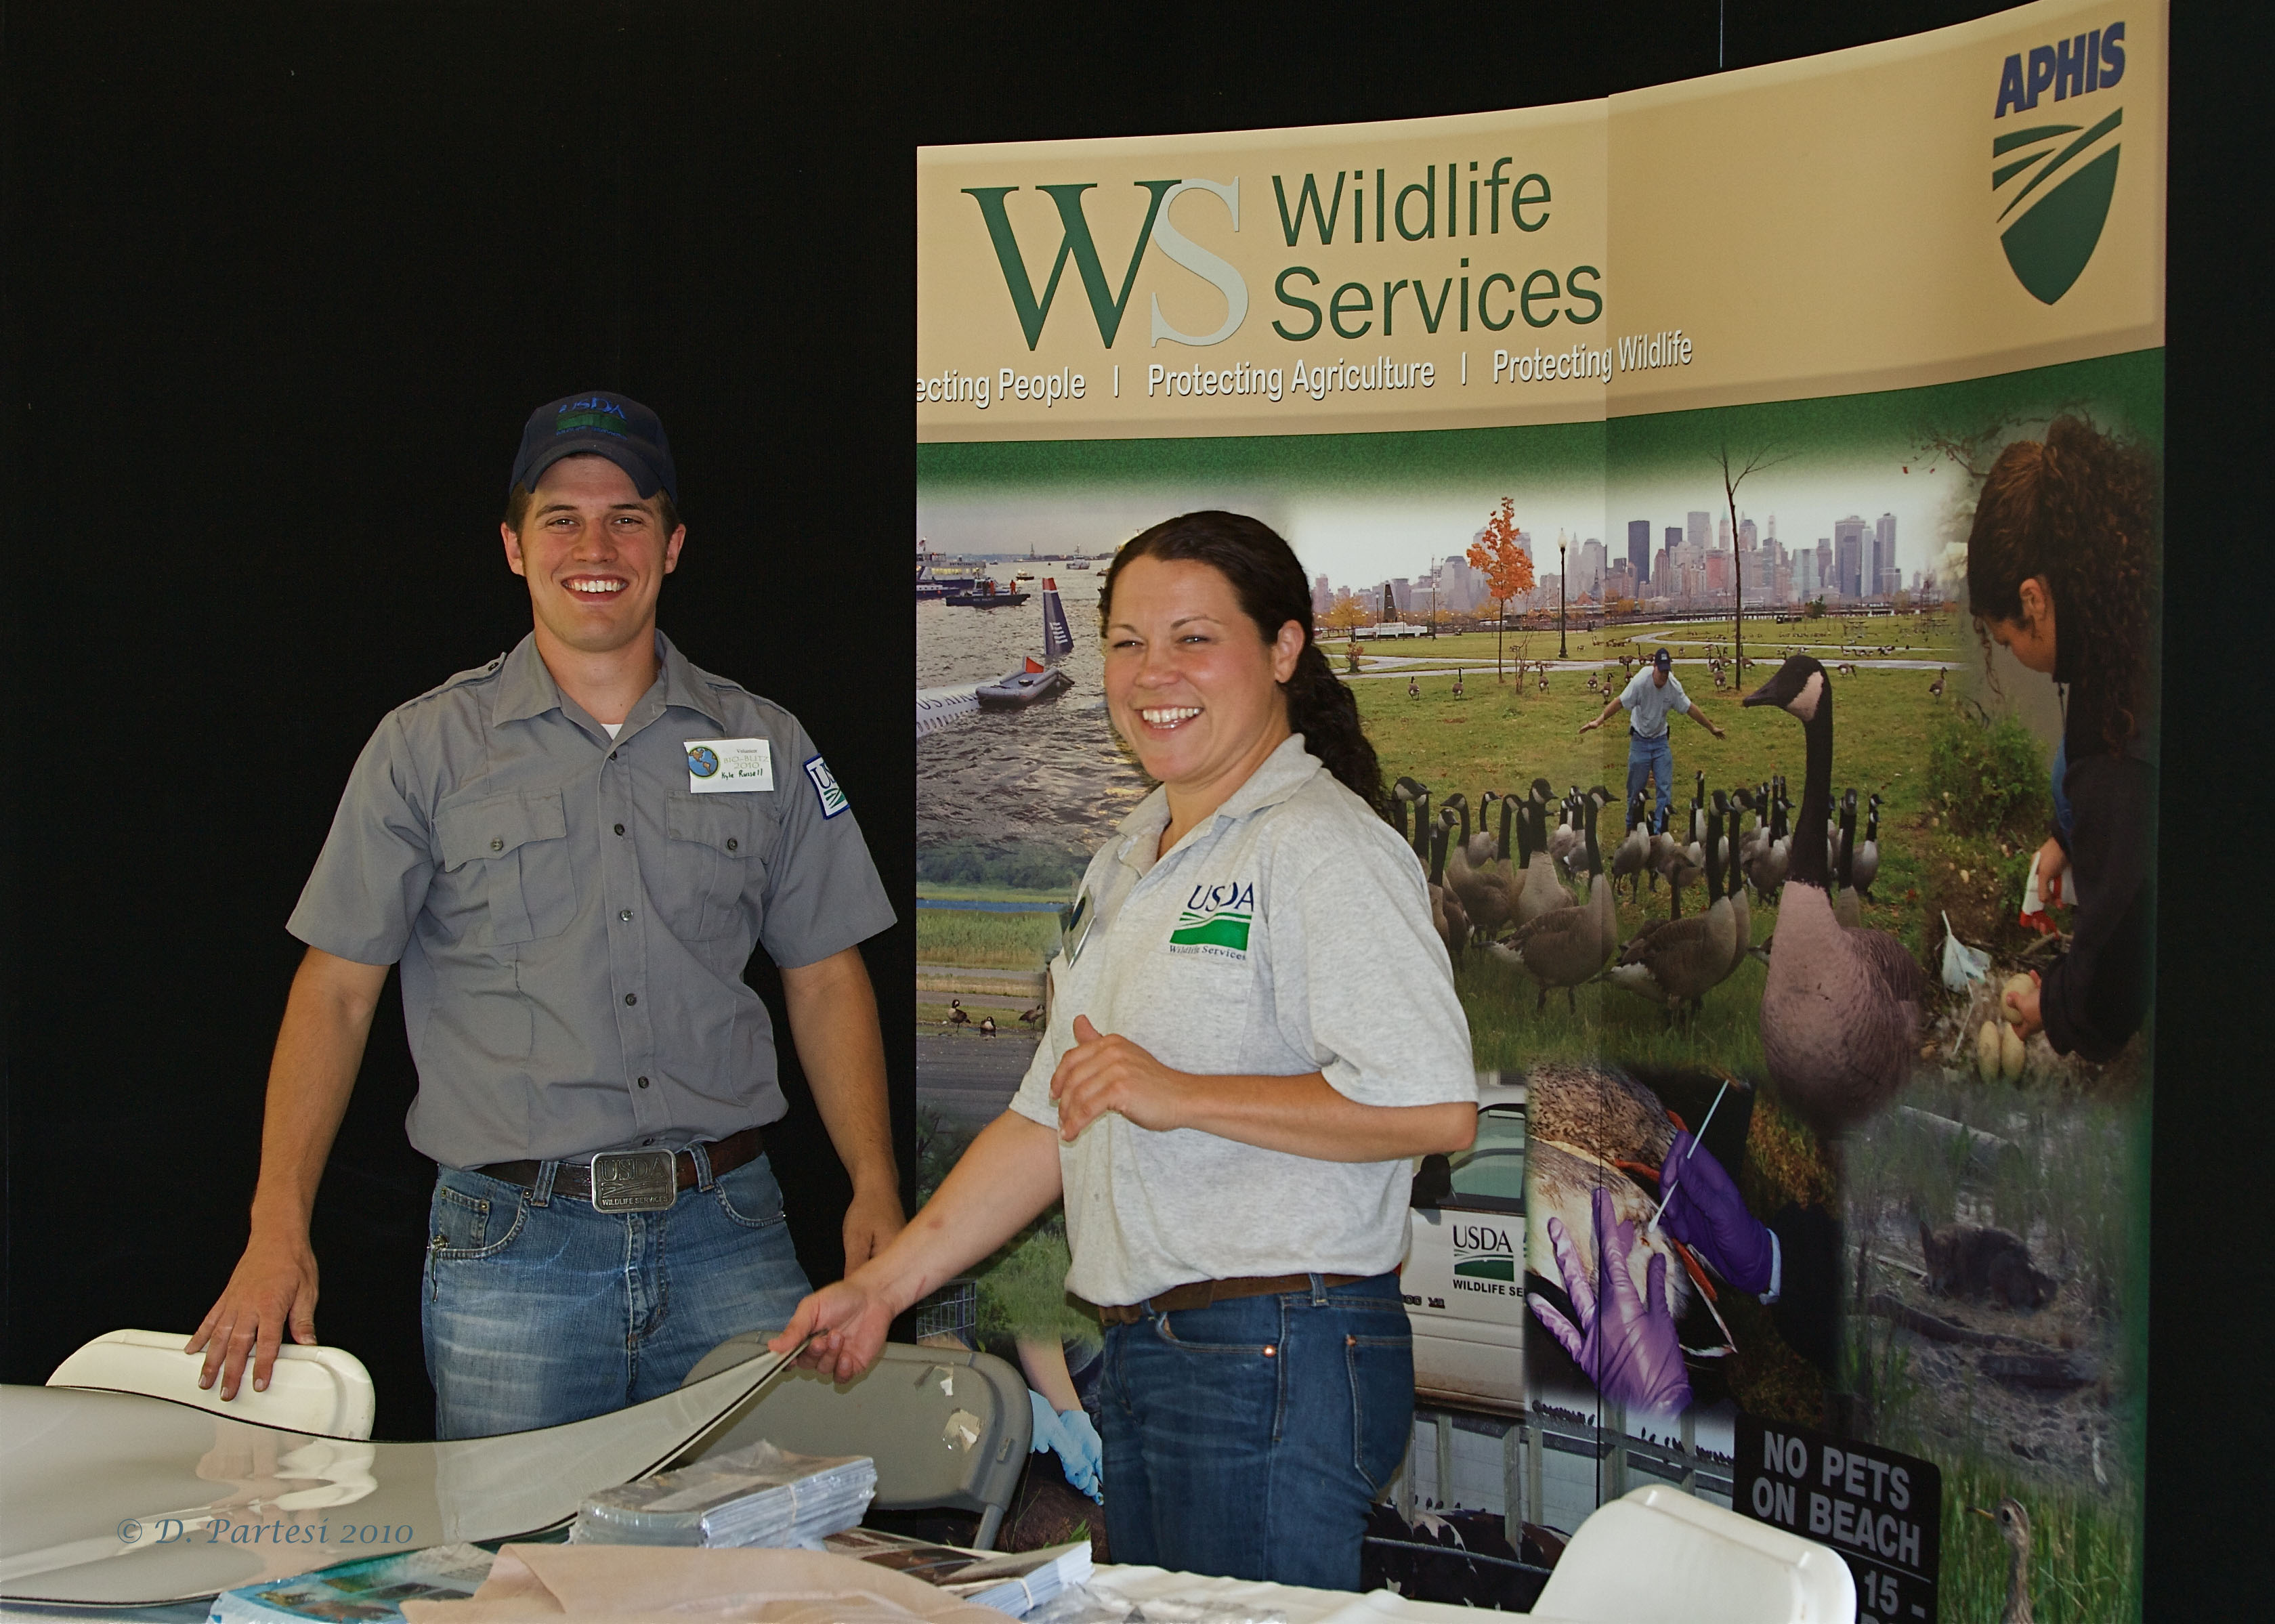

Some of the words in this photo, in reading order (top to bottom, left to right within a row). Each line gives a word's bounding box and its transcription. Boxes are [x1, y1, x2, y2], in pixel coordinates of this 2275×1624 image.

[1994, 21, 2125, 119] APHIS
[1272, 156, 1552, 247] Wildlife
[961, 176, 1249, 351] WS
[1271, 258, 1603, 341] Services
[999, 366, 1086, 408] People
[1149, 362, 1283, 402] Protecting
[1291, 356, 1435, 400] Agriculture
[1494, 343, 1613, 383] Protecting
[1619, 330, 1693, 372] Wildlife
[721, 771, 734, 781] Kyle
[738, 768, 763, 777] Russell
[1187, 882, 1254, 912] USDA
[1202, 945, 1246, 961] Services
[599, 1157, 669, 1182] USDA
[602, 1197, 634, 1206] WILDLIFE
[635, 1196, 668, 1205] SERVICES
[1453, 1224, 1513, 1253] USDA
[1453, 1279, 1505, 1295] WILDLIFE
[1509, 1286, 1523, 1297] SE
[1764, 1430, 1808, 1479] NO
[1822, 1445, 1910, 1511] PETS
[1752, 1477, 1795, 1525] ON
[1809, 1492, 1921, 1567] BEACH
[1864, 1570, 1899, 1615] 15
